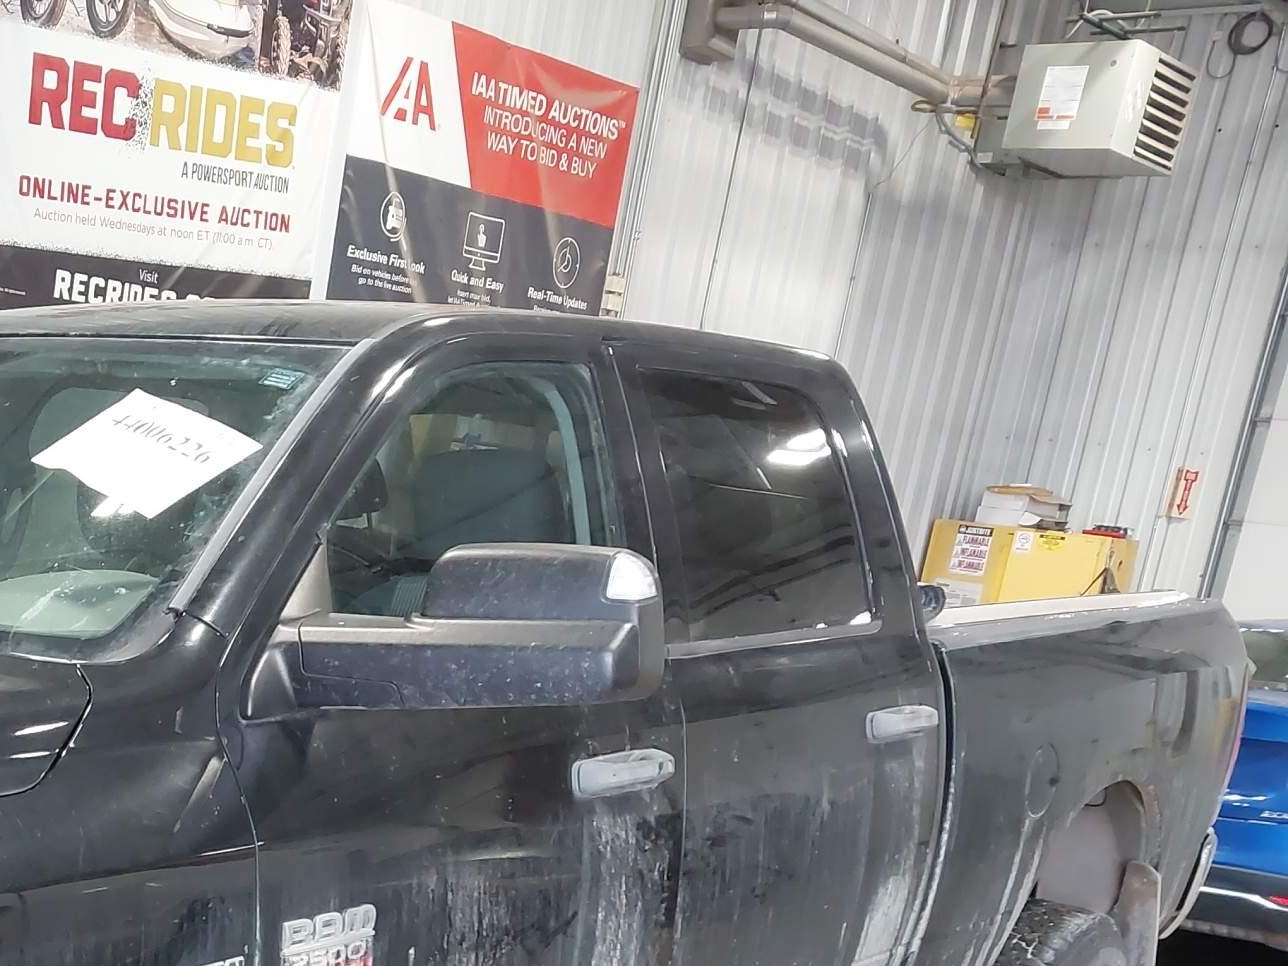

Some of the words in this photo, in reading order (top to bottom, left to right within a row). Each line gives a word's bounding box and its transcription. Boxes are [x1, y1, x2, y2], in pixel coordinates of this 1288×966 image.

[471, 71, 496, 102] IAA
[498, 82, 547, 116] TIMED
[483, 105, 567, 148] INTRODUCING
[568, 132, 577, 151] A
[580, 135, 608, 159] NEW
[487, 130, 519, 156] WAY
[519, 139, 538, 162] TO
[539, 146, 558, 168] BID
[558, 152, 569, 172] &
[570, 156, 598, 180] BUY
[181, 161, 189, 179] A
[191, 162, 253, 189] POWERSPORT
[253, 171, 290, 194] AUCTION
[18, 174, 210, 223] ONLINE-EXCLUSIVE
[217, 205, 291, 233] AUCTION
[33, 207, 73, 224] Auction
[75, 210, 96, 227] held
[98, 214, 155, 238] Wednesdays
[157, 225, 167, 237] at
[171, 228, 194, 240] noon
[197, 229, 211, 242] ET
[346, 244, 388, 265] Exclusive
[388, 253, 408, 269] First
[410, 260, 426, 274] ook
[351, 263, 362, 274] Bid
[138, 268, 160, 285] Visit
[451, 269, 468, 285] Quick
[469, 276, 485, 288] and
[485, 277, 505, 294] Easy
[527, 286, 563, 305] Real-Time
[563, 295, 587, 311] Updates
